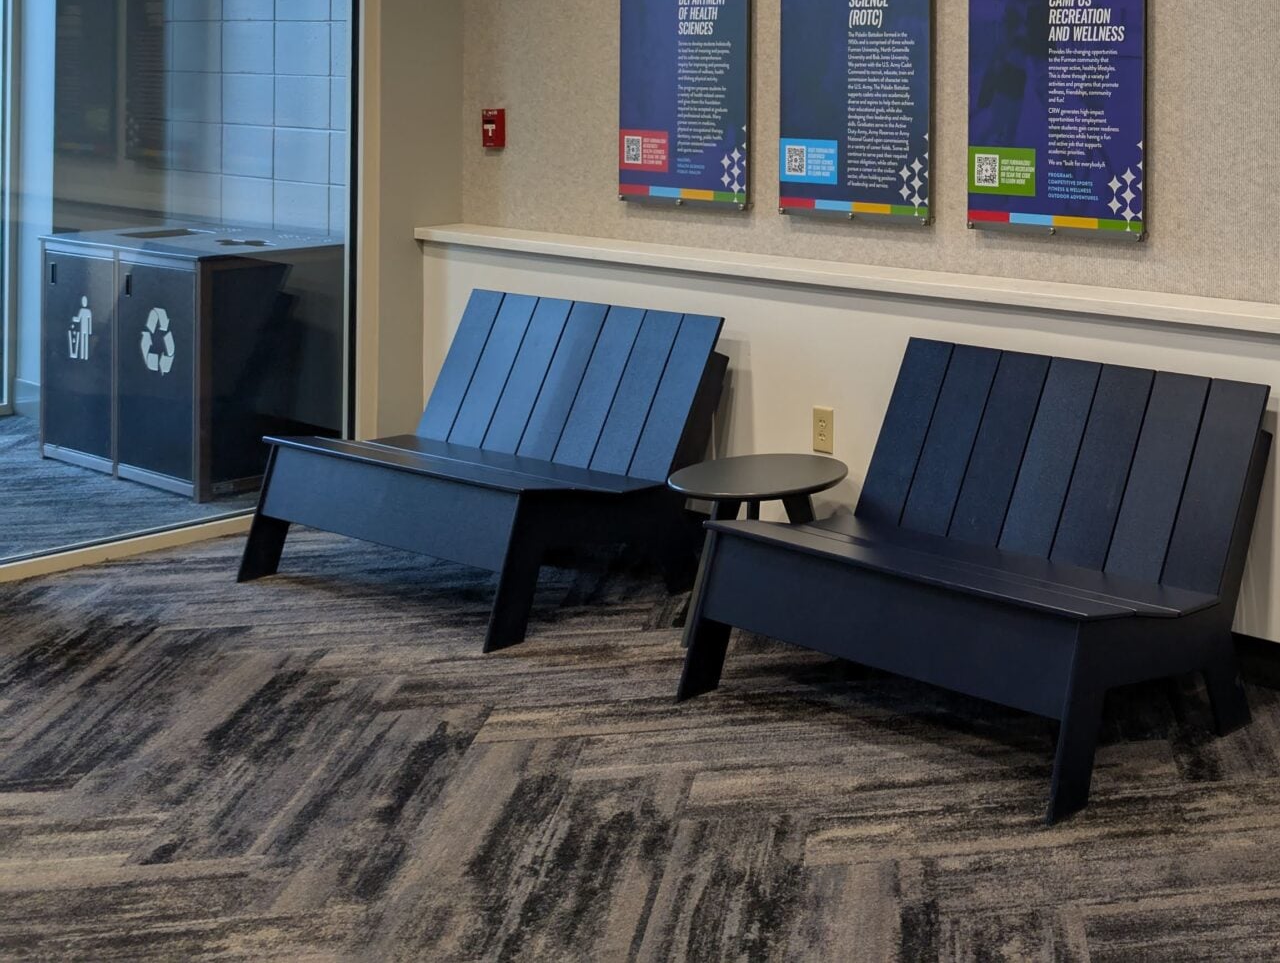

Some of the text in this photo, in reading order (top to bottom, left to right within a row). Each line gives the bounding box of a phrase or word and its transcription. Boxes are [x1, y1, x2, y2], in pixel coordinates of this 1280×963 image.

[678, 7, 717, 20] OF HEALTH
[849, 9, 883, 28] (ROTC)
[1049, 8, 1111, 24] RECREATION
[678, 22, 713, 35] SCIENCES
[1049, 25, 1124, 41] AND WELLNESS
